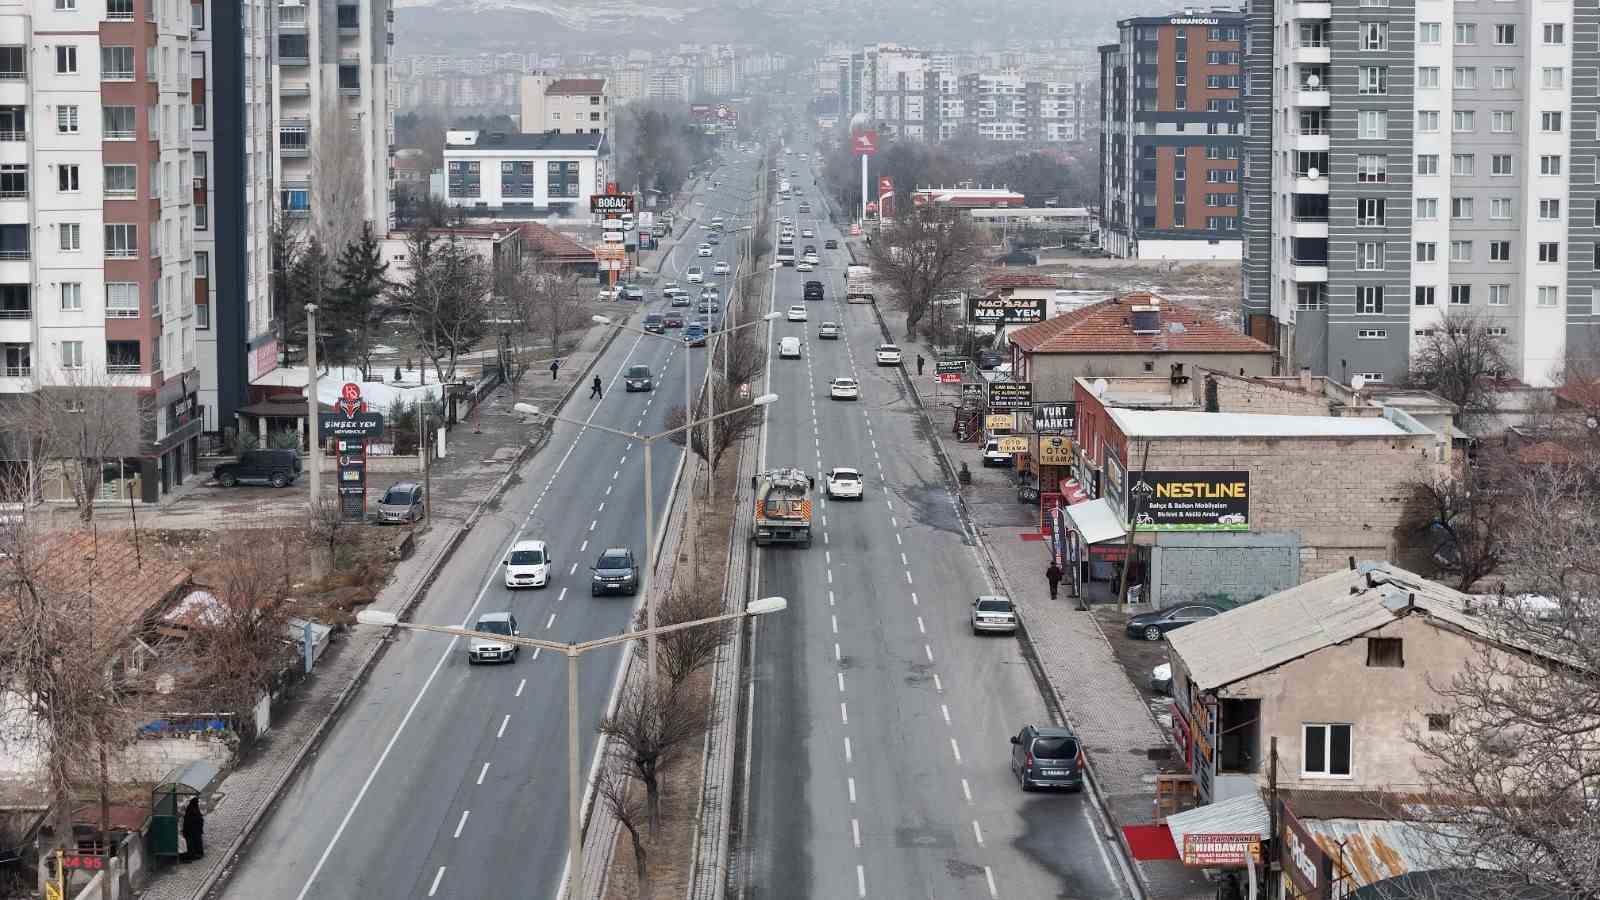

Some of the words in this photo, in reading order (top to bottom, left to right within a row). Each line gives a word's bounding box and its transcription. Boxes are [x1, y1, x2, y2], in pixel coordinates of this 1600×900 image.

[1014, 309, 1041, 317] YEM
[1042, 406, 1068, 418] YURT
[1035, 418, 1075, 429] MARKET
[1046, 447, 1068, 455] OTO
[1041, 455, 1073, 464] YIKAMA
[1155, 482, 1247, 498] NESTLINE
